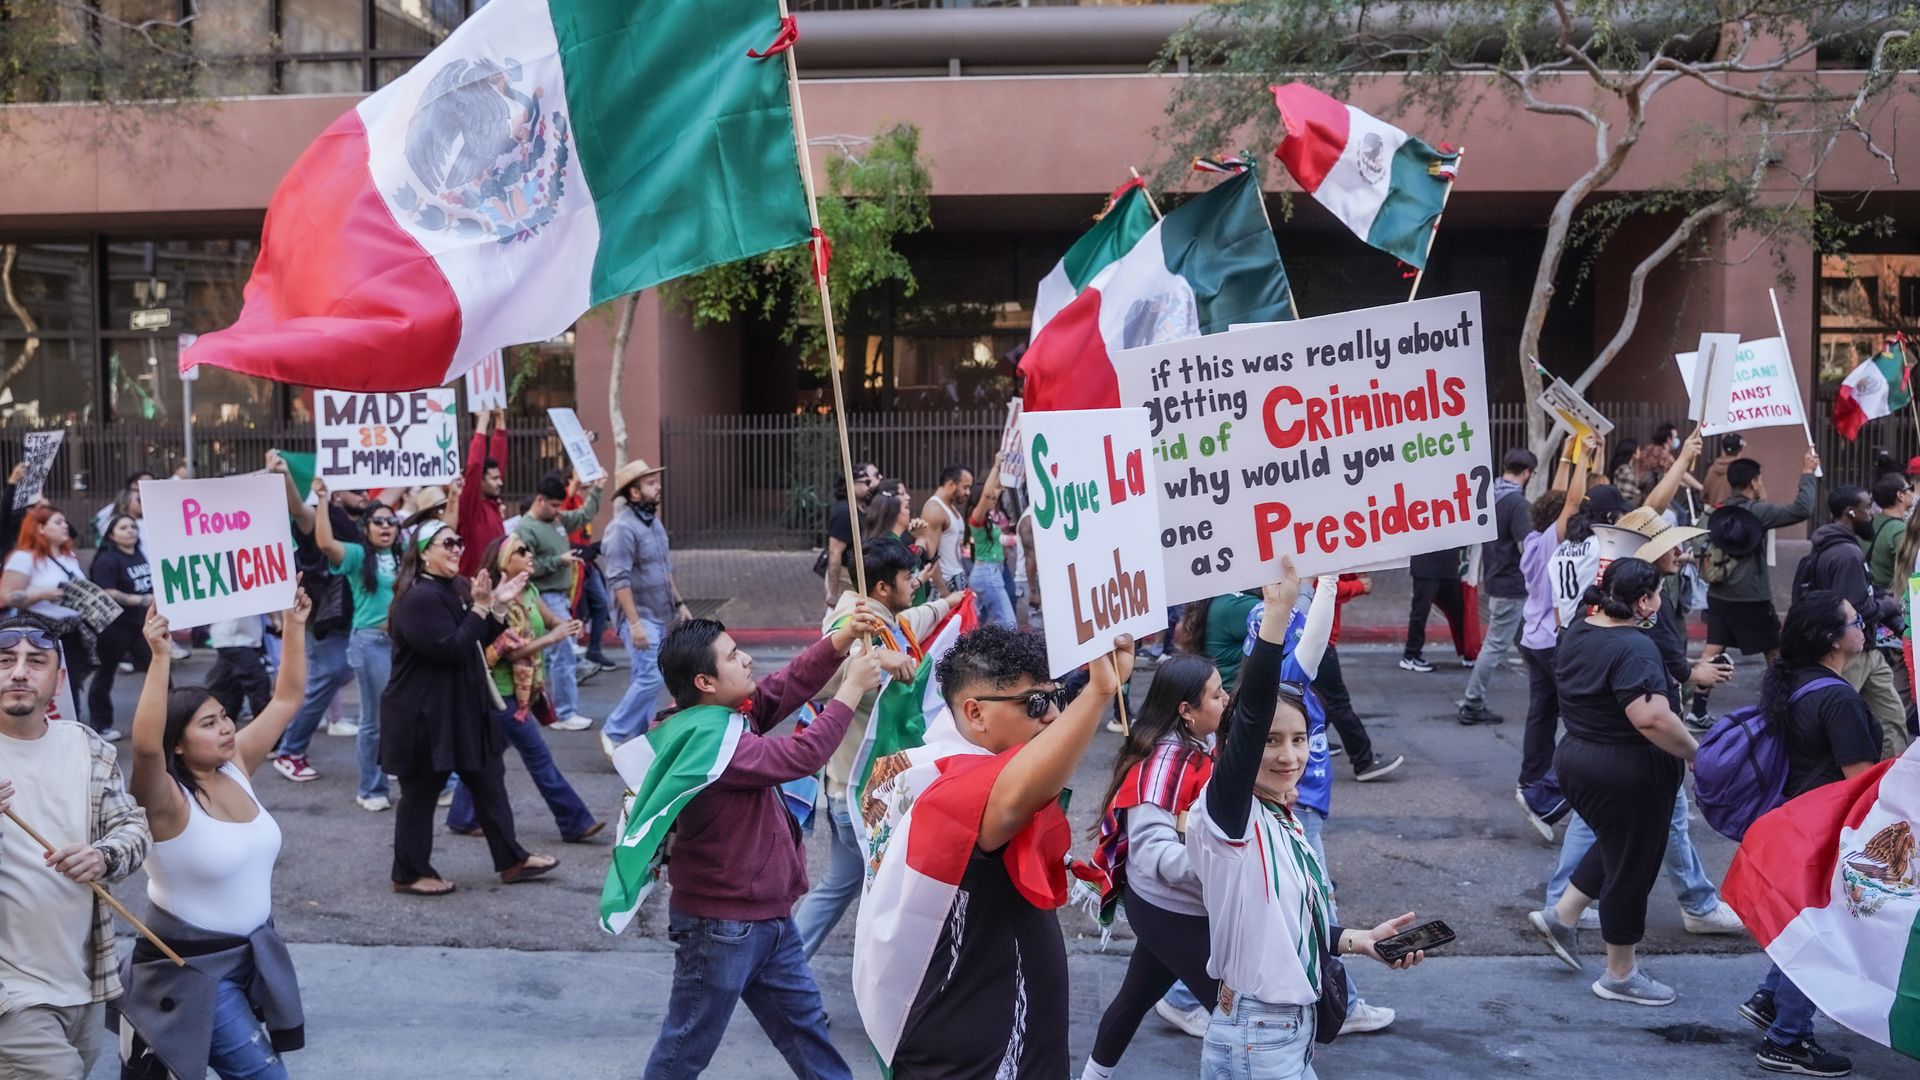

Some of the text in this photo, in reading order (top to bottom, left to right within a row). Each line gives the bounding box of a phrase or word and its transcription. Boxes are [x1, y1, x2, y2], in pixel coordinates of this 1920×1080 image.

[1151, 310, 1473, 391] if this was really about
[1735, 348, 1755, 362] NO
[1733, 364, 1778, 383] ICANS
[324, 392, 428, 426] MADE
[1143, 389, 1248, 437] getting
[1727, 404, 1792, 423] ORTATION
[1731, 385, 1772, 403] AINST
[321, 437, 458, 477] Immigrants
[1200, 421, 1232, 457] of
[1164, 421, 1474, 505] why would you elect
[1031, 433, 1100, 541] Sigue
[1103, 434, 1146, 506] La
[182, 498, 251, 536] PROUD
[1161, 520, 1213, 548] one
[1191, 465, 1491, 576] as President?
[161, 542, 288, 604] MEXICAN
[1558, 560, 1580, 600] 10
[1067, 548, 1150, 646] Lucha
